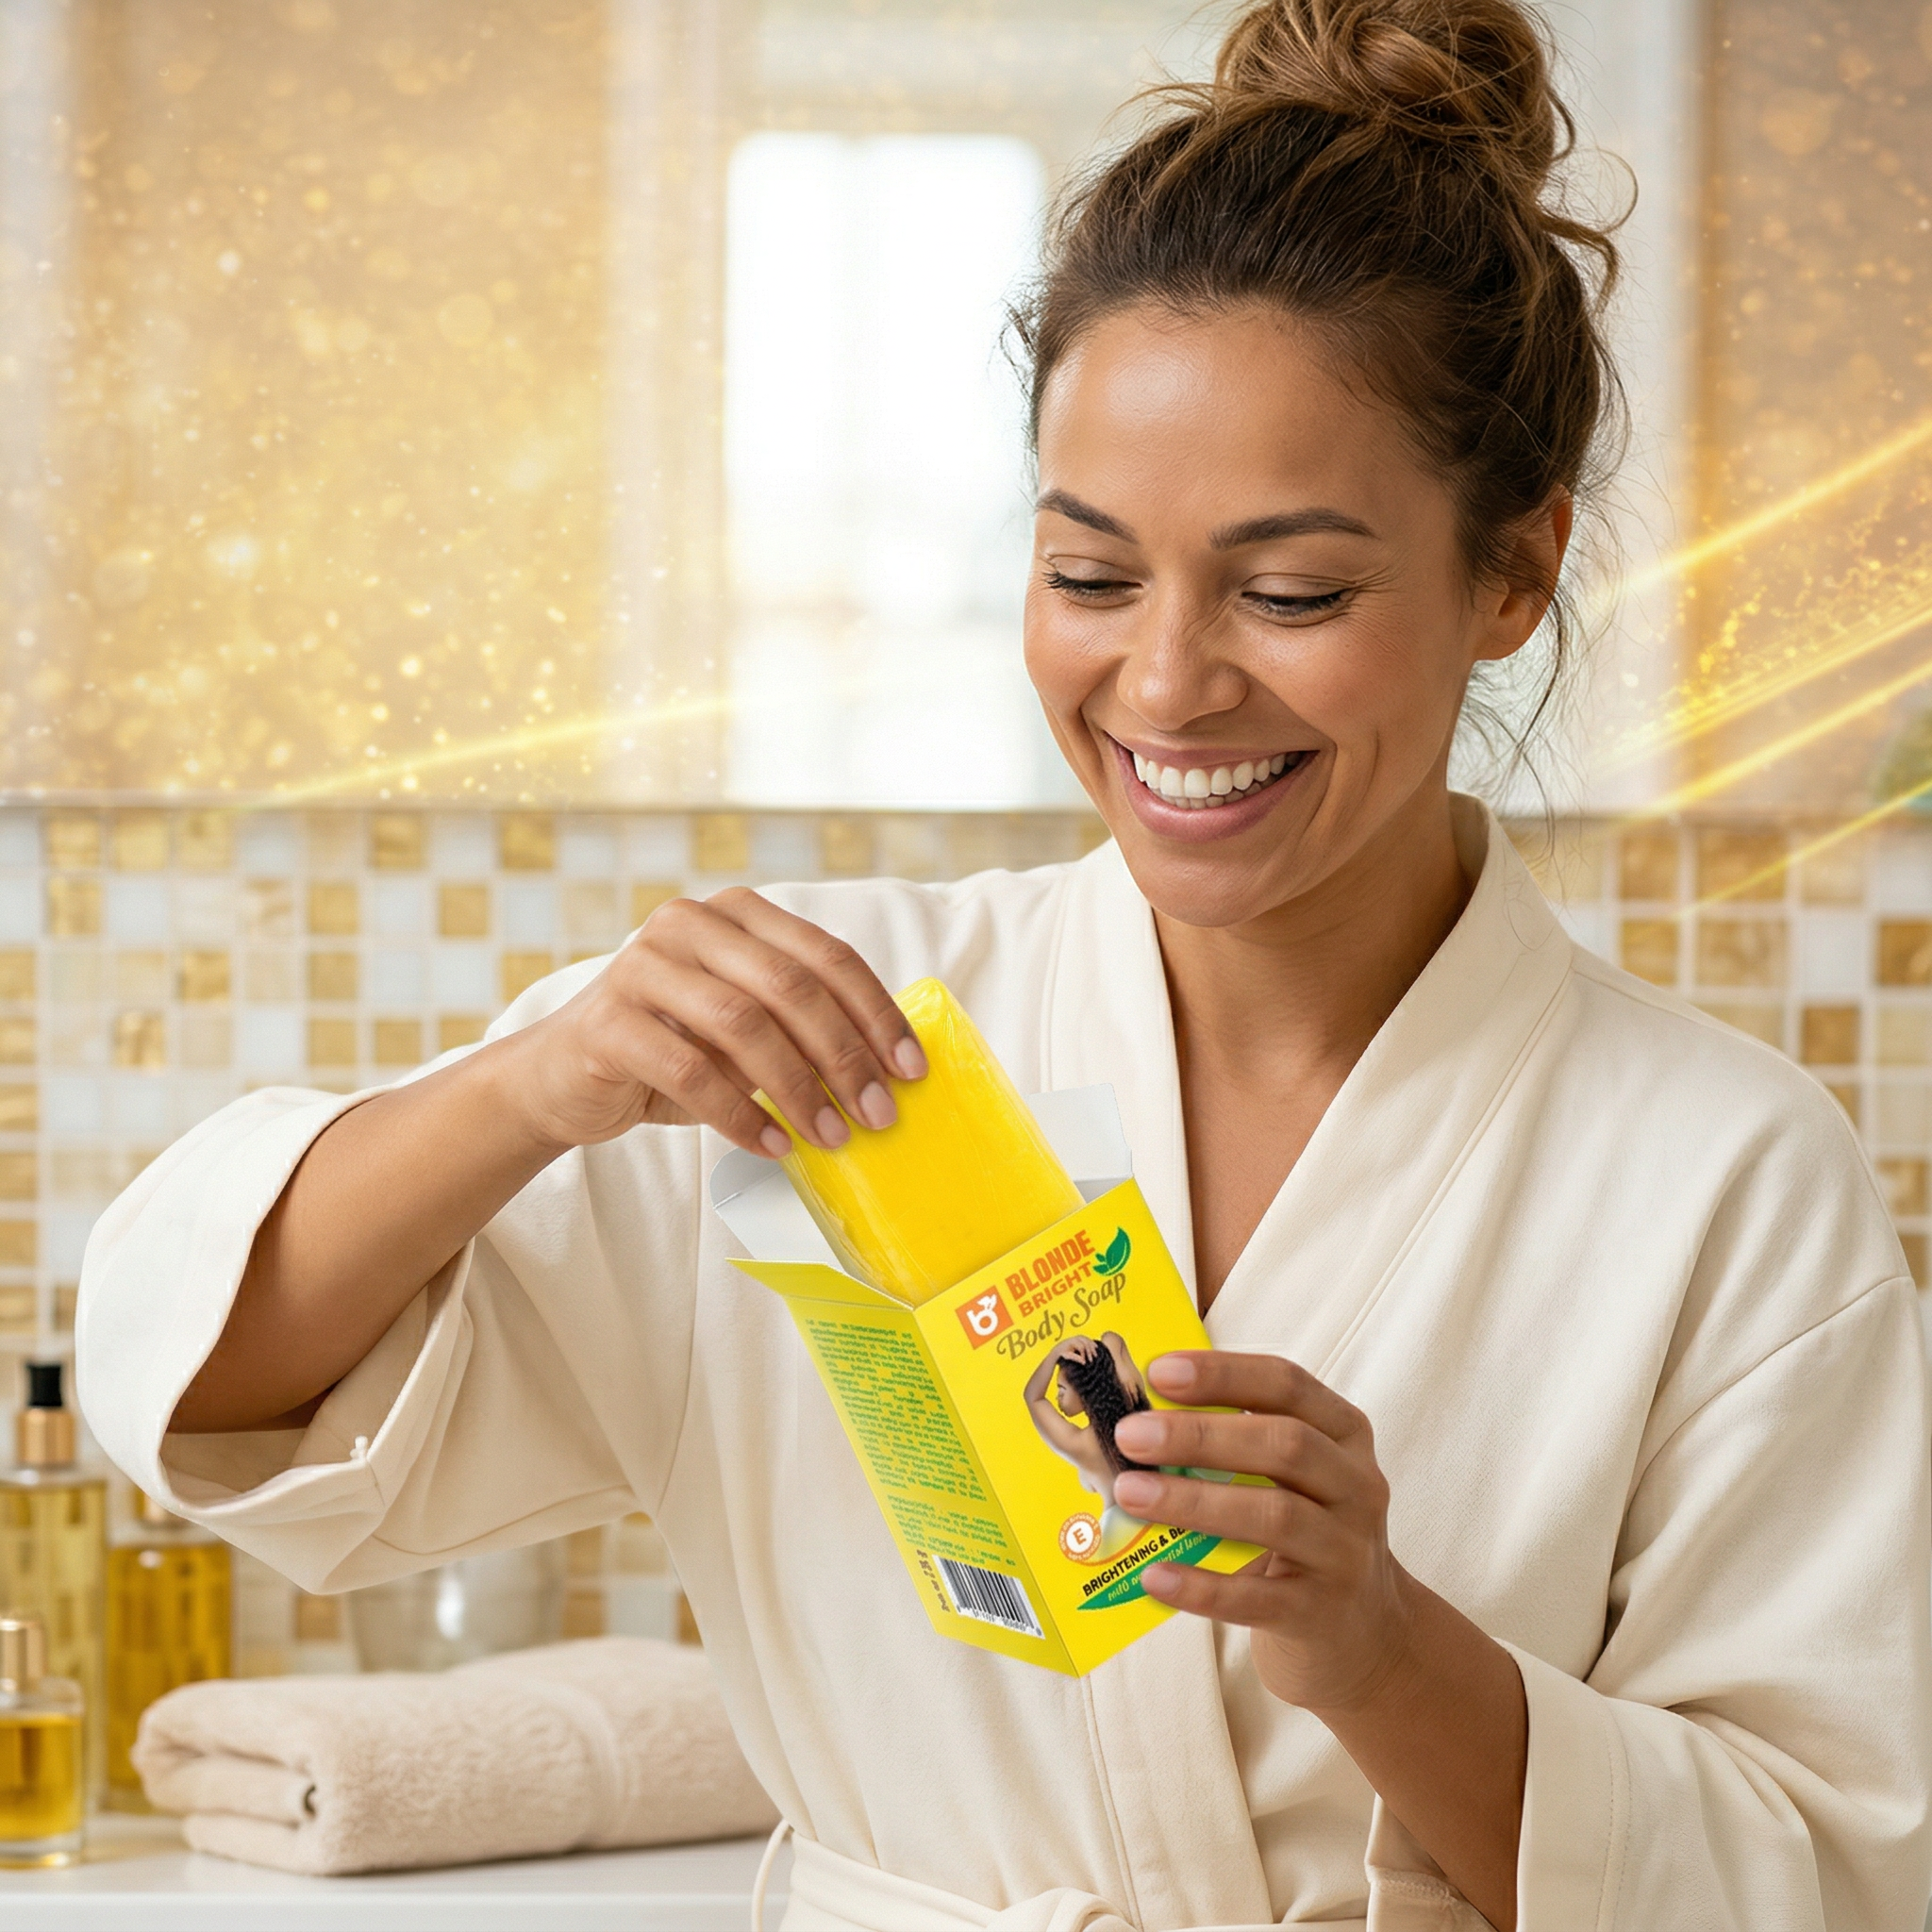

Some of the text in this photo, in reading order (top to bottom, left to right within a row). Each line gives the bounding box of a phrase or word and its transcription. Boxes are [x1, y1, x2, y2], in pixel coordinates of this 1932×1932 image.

[1005, 1229, 1096, 1302] BLONDE
[1018, 1261, 1092, 1318] BRIGHT
[996, 1272, 1126, 1360] Body Soap
[1073, 1527, 1087, 1545] E
[1082, 1539, 1159, 1597] BRIGHTENING
[1158, 1534, 1170, 1547] &
